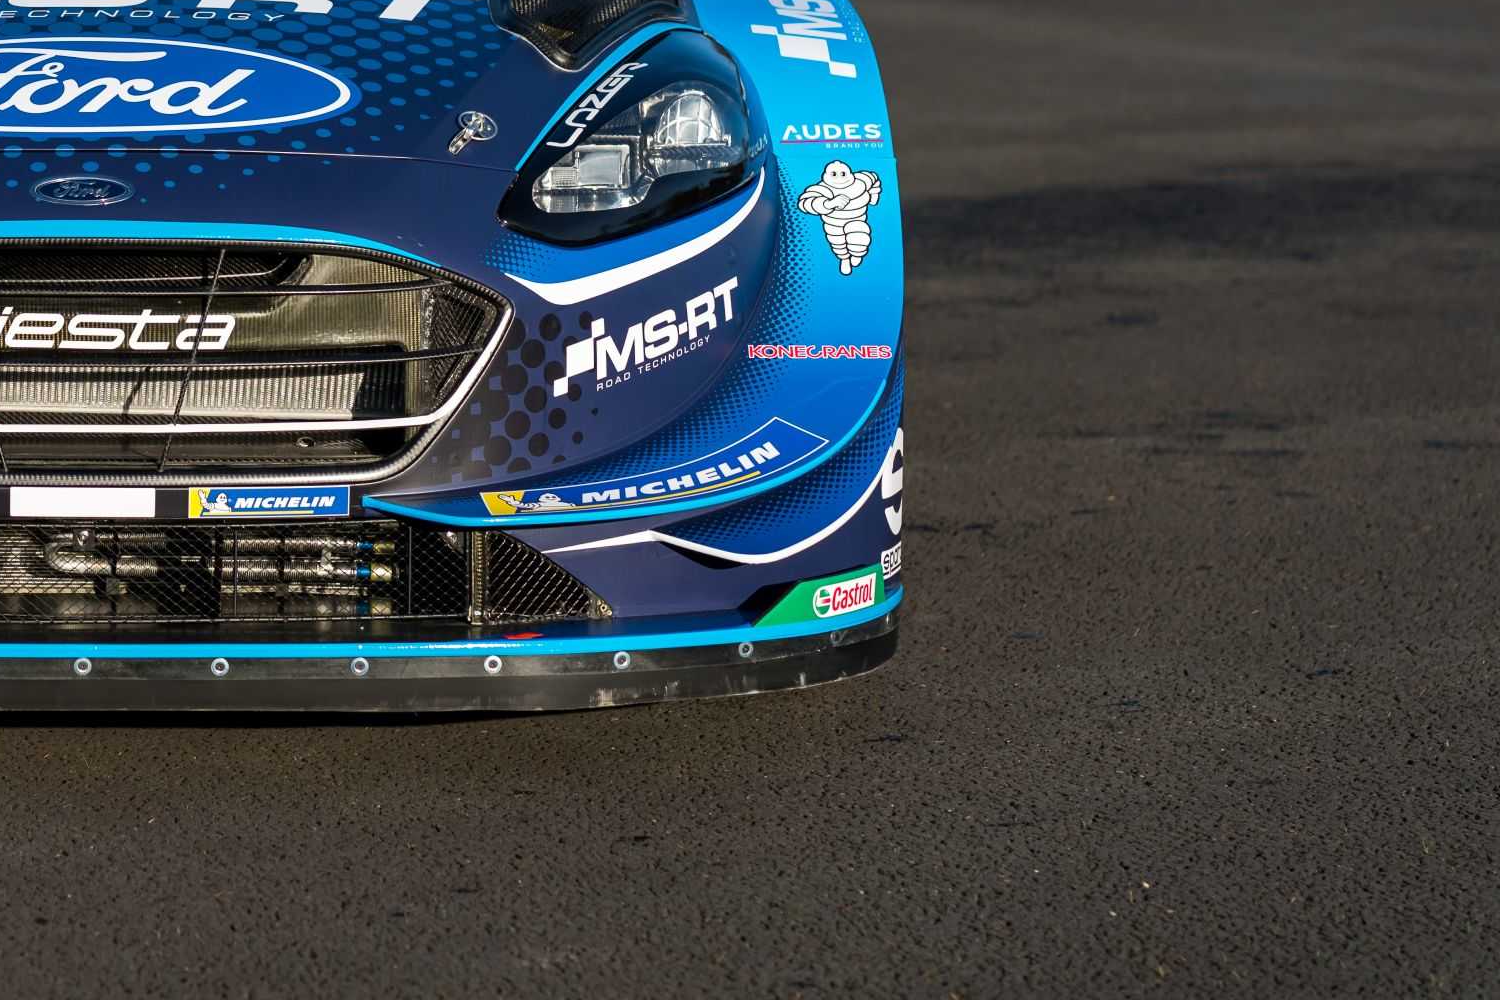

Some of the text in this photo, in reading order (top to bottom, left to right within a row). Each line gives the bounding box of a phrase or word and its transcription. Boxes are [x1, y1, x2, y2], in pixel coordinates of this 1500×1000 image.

[546, 63, 649, 148] LAZER
[782, 123, 882, 141] AUDES
[53, 180, 113, 200] Ford
[596, 276, 739, 381] MS-RT
[596, 334, 711, 392] ROAD TECHNOLOGY
[747, 344, 893, 360] KONECRANES
[581, 441, 781, 504] MICHELIN
[234, 495, 336, 509] MICHELIN
[832, 577, 873, 612] Castrol
